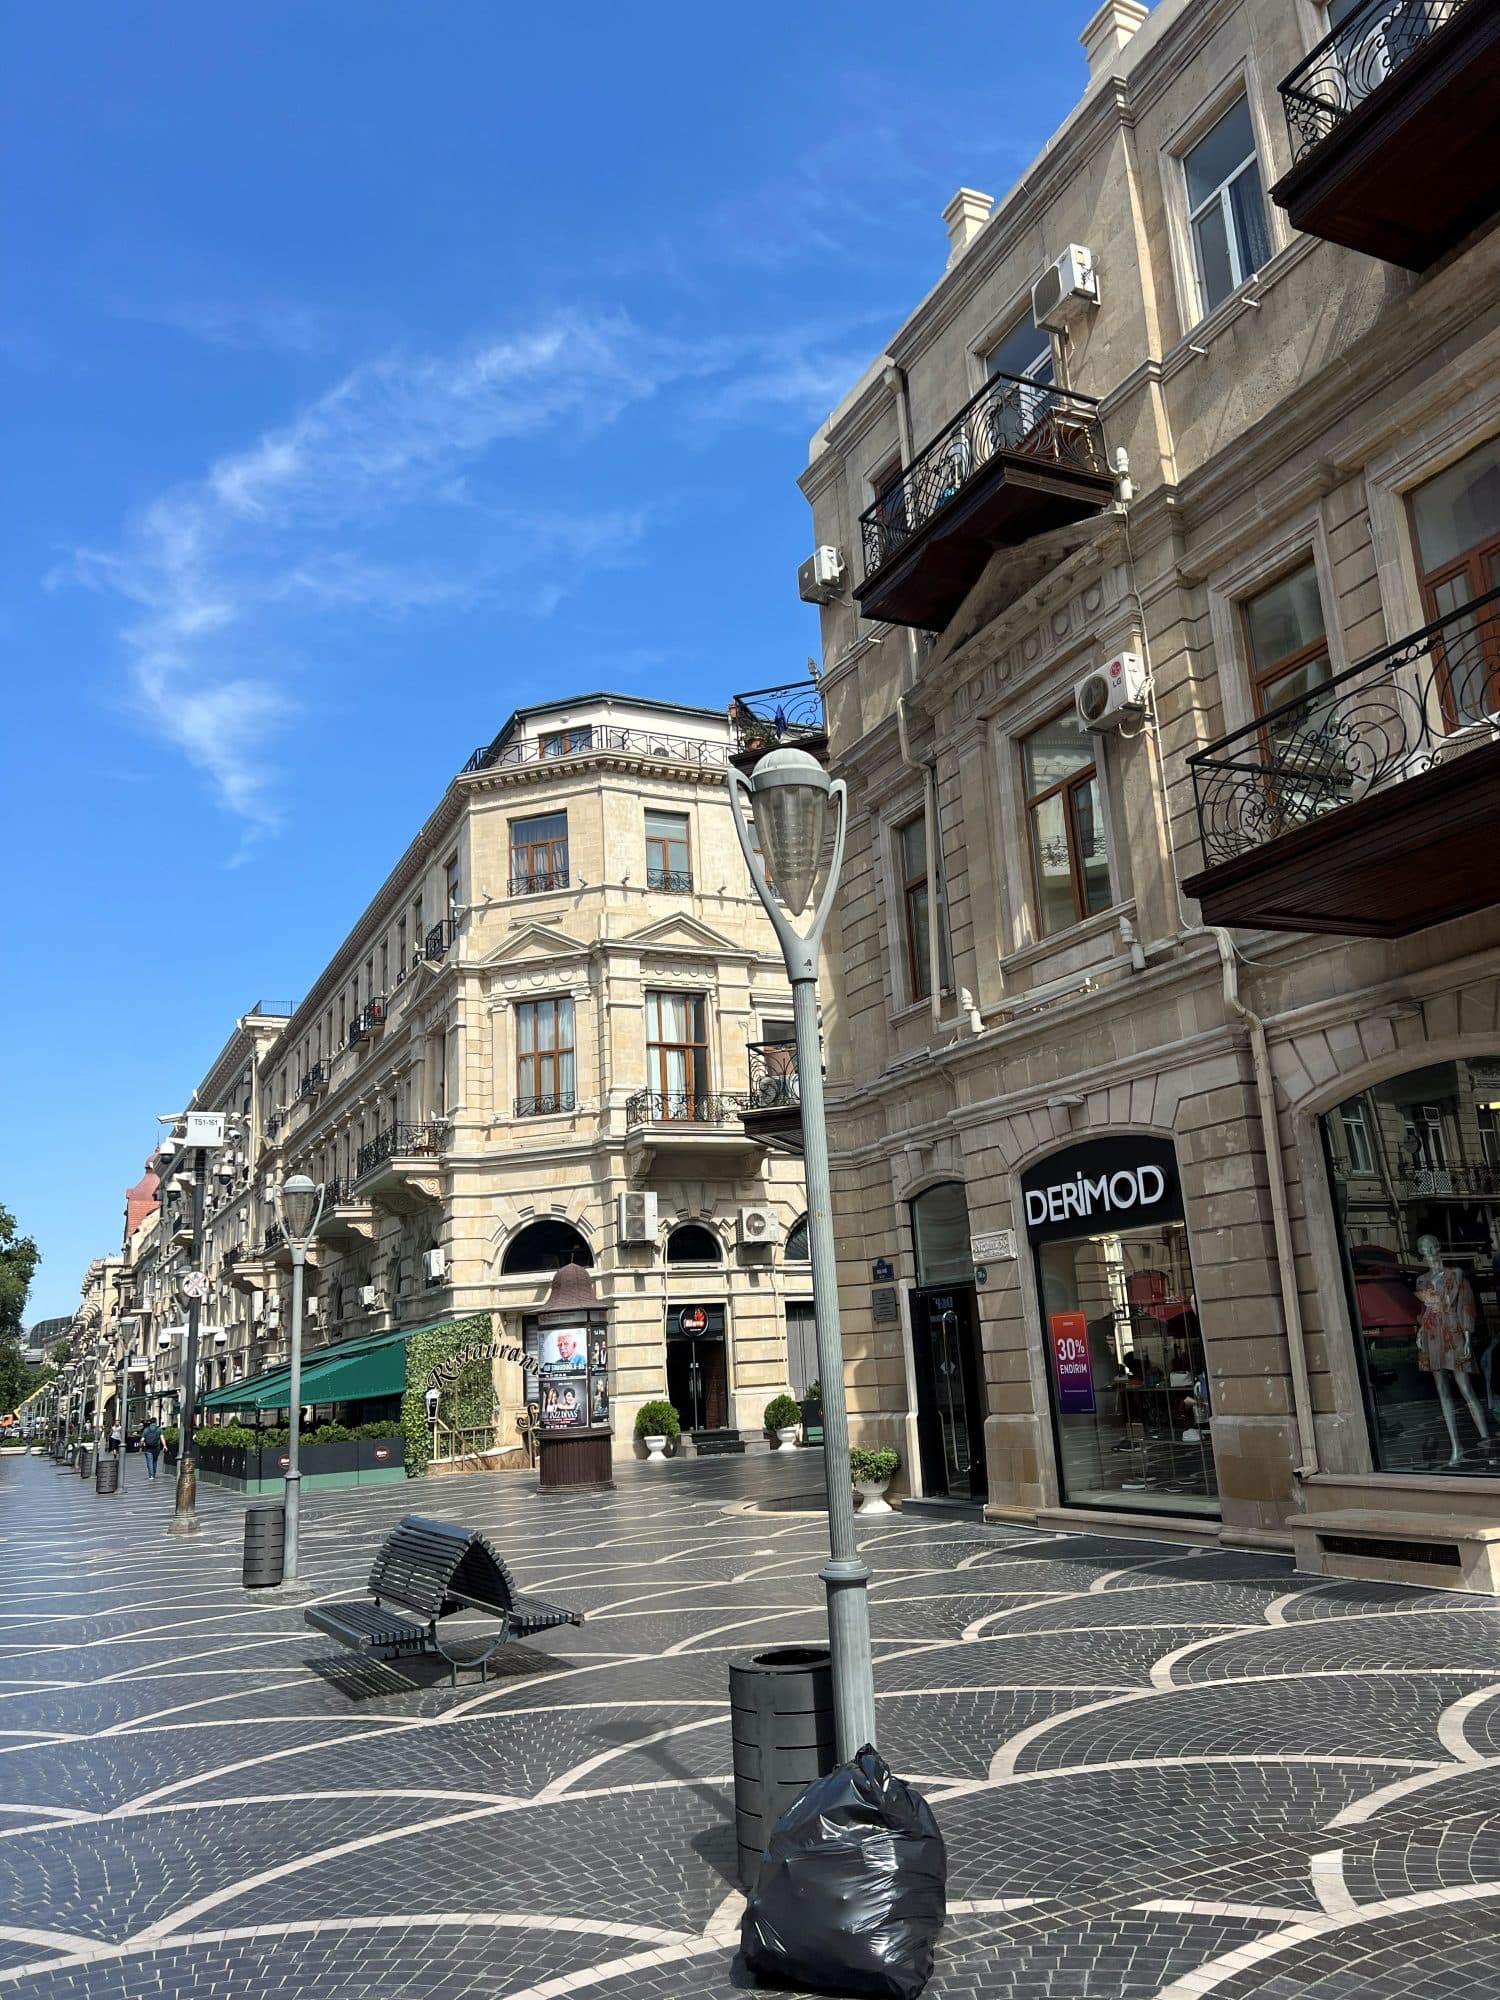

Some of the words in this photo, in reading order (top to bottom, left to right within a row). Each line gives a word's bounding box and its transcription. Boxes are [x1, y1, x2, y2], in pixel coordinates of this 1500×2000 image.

[1112, 677, 1122, 688] LG
[1025, 1165, 1165, 1226] DERİMOD
[1057, 1338, 1085, 1361] 30%
[1060, 1361, 1088, 1375] ENDİRİM
